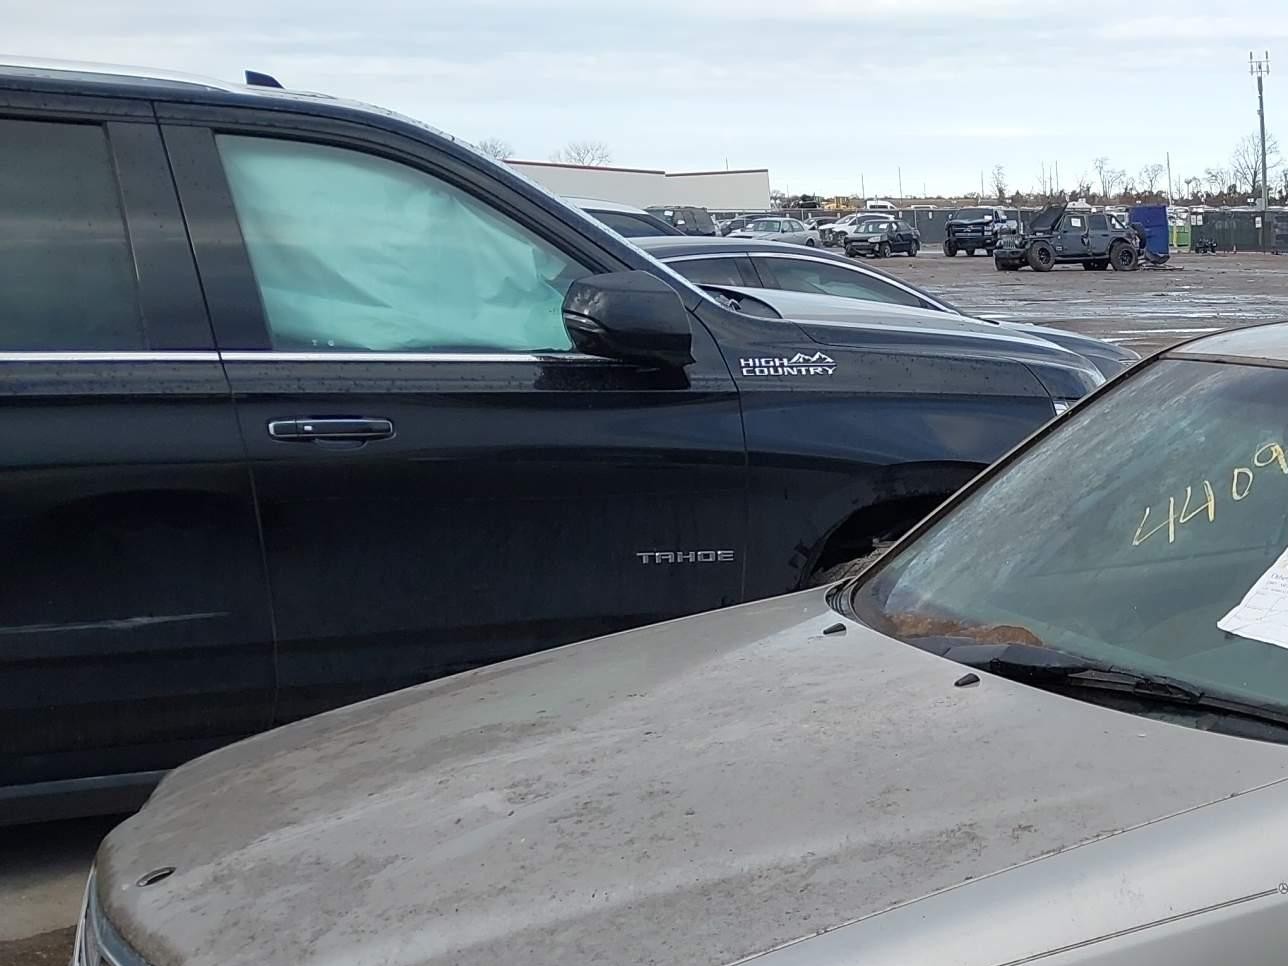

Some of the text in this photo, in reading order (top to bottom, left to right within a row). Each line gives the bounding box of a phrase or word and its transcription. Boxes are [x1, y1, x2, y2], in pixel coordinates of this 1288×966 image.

[740, 358, 788, 367] HIGH
[742, 366, 837, 376] COUNTRY
[637, 550, 735, 564] TAHOE
